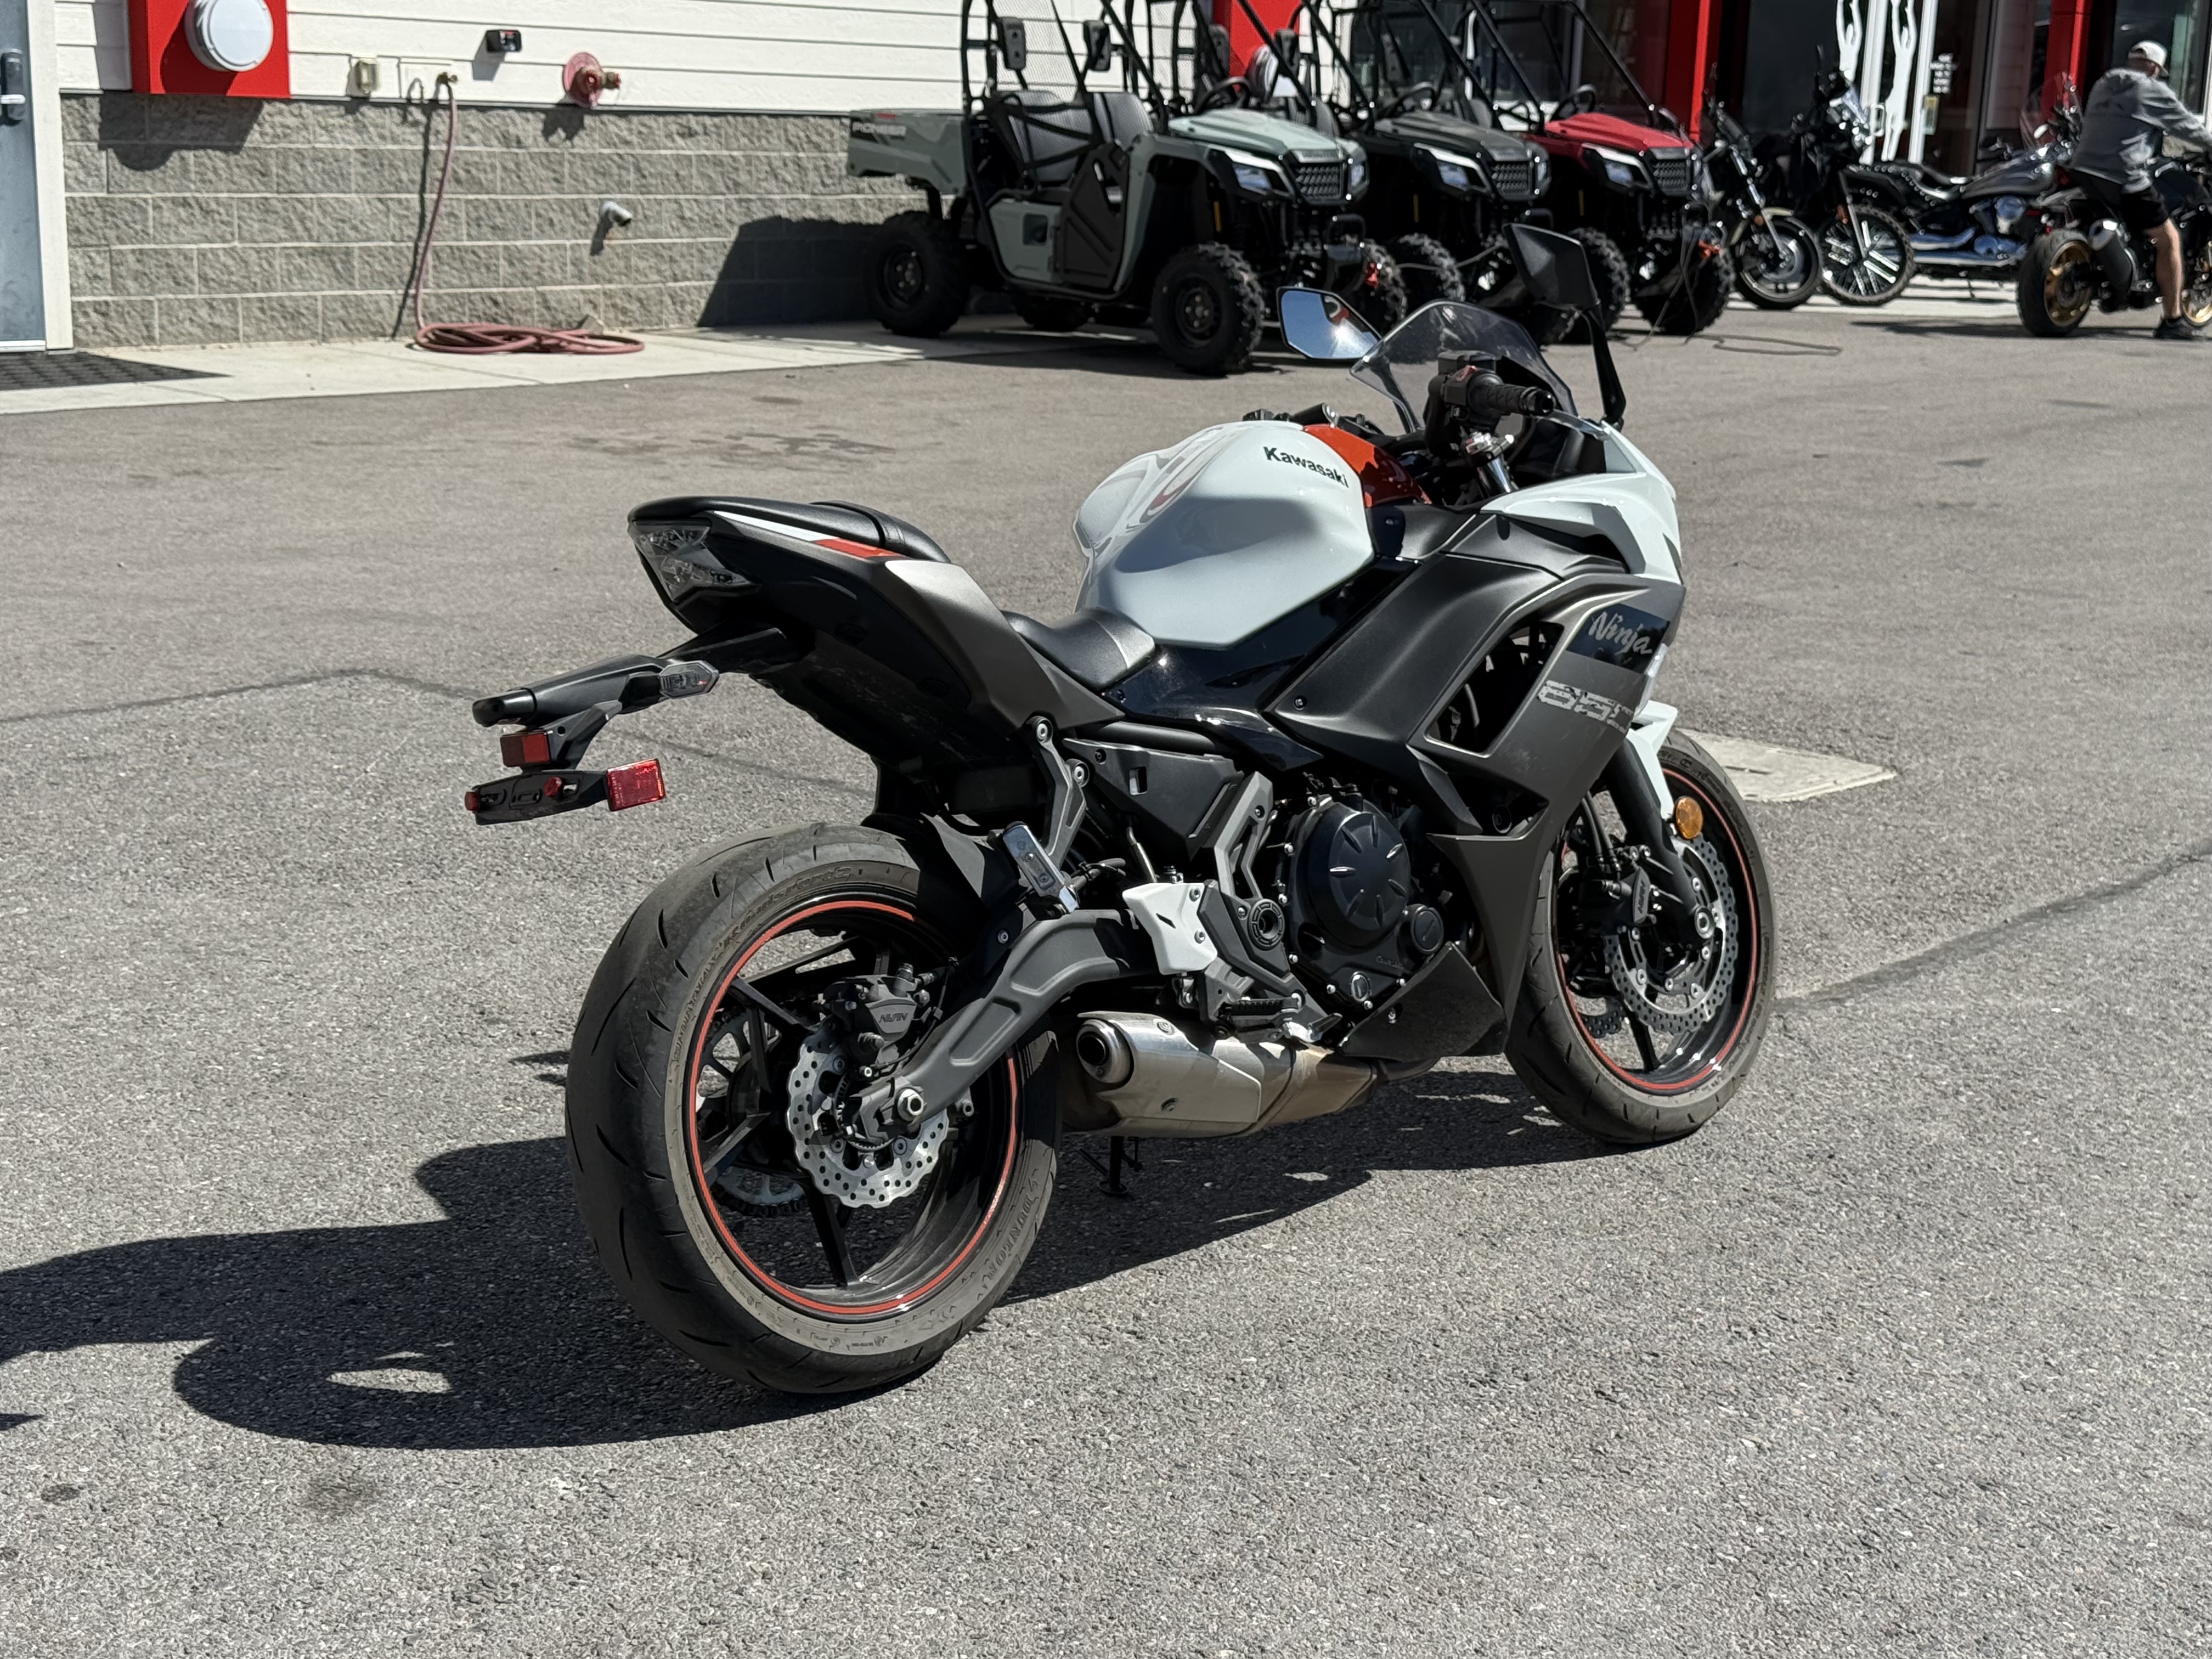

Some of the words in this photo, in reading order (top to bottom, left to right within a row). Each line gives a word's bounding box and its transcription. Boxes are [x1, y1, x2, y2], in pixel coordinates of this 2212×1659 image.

[853, 121, 906, 137] PIONEER
[1263, 447, 1349, 488] Kawasaki
[1588, 611, 1652, 654] Ninja
[1538, 680, 1633, 733] 650
